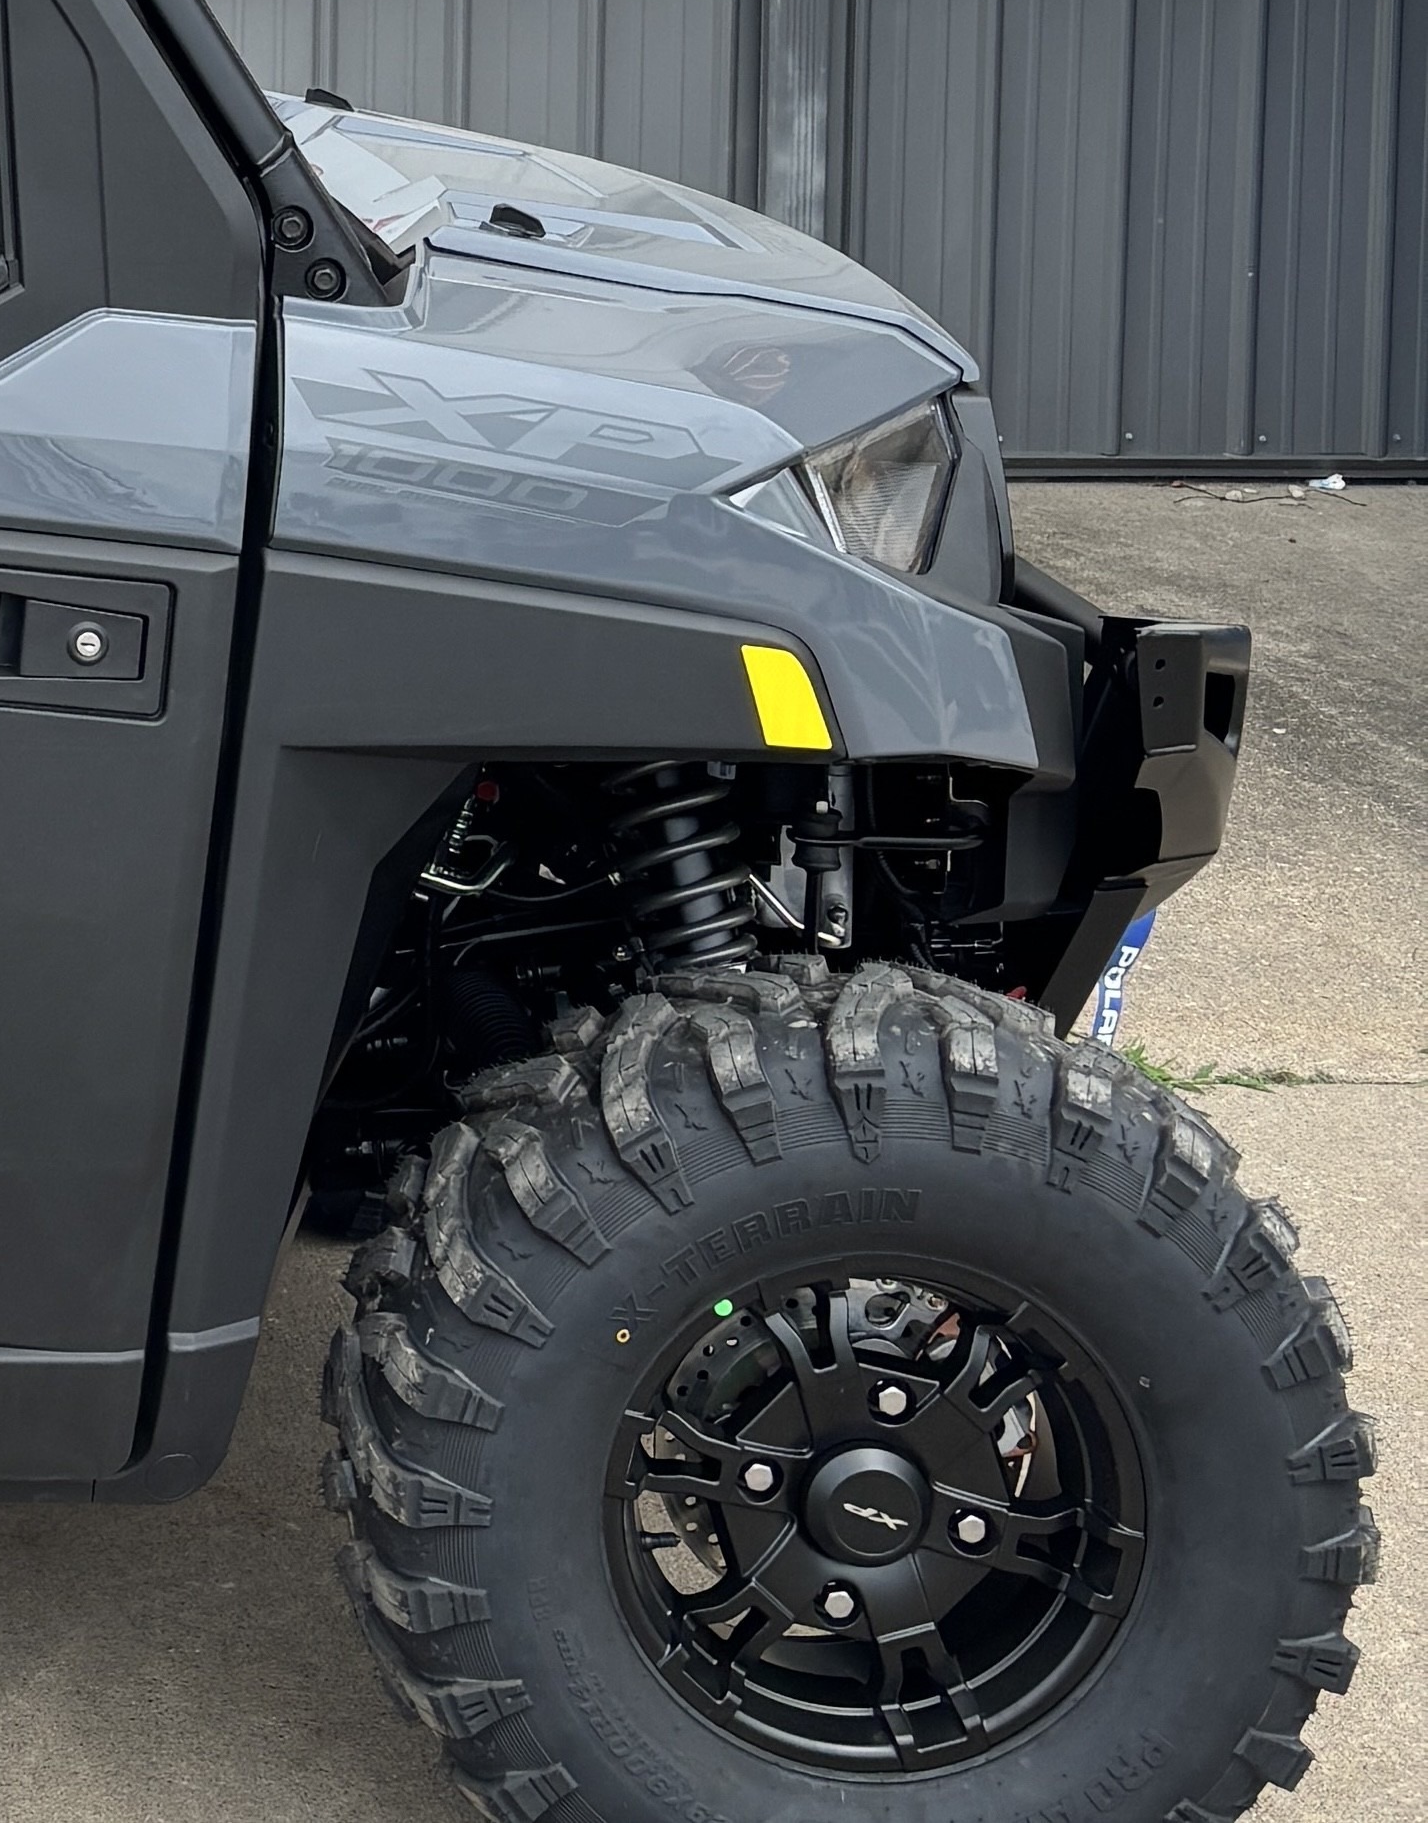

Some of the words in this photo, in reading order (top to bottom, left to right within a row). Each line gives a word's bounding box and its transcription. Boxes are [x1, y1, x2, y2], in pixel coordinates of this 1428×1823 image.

[315, 367, 706, 462] XP
[609, 1187, 923, 1330] X-TERRAIN
[843, 1502, 909, 1531] XP
